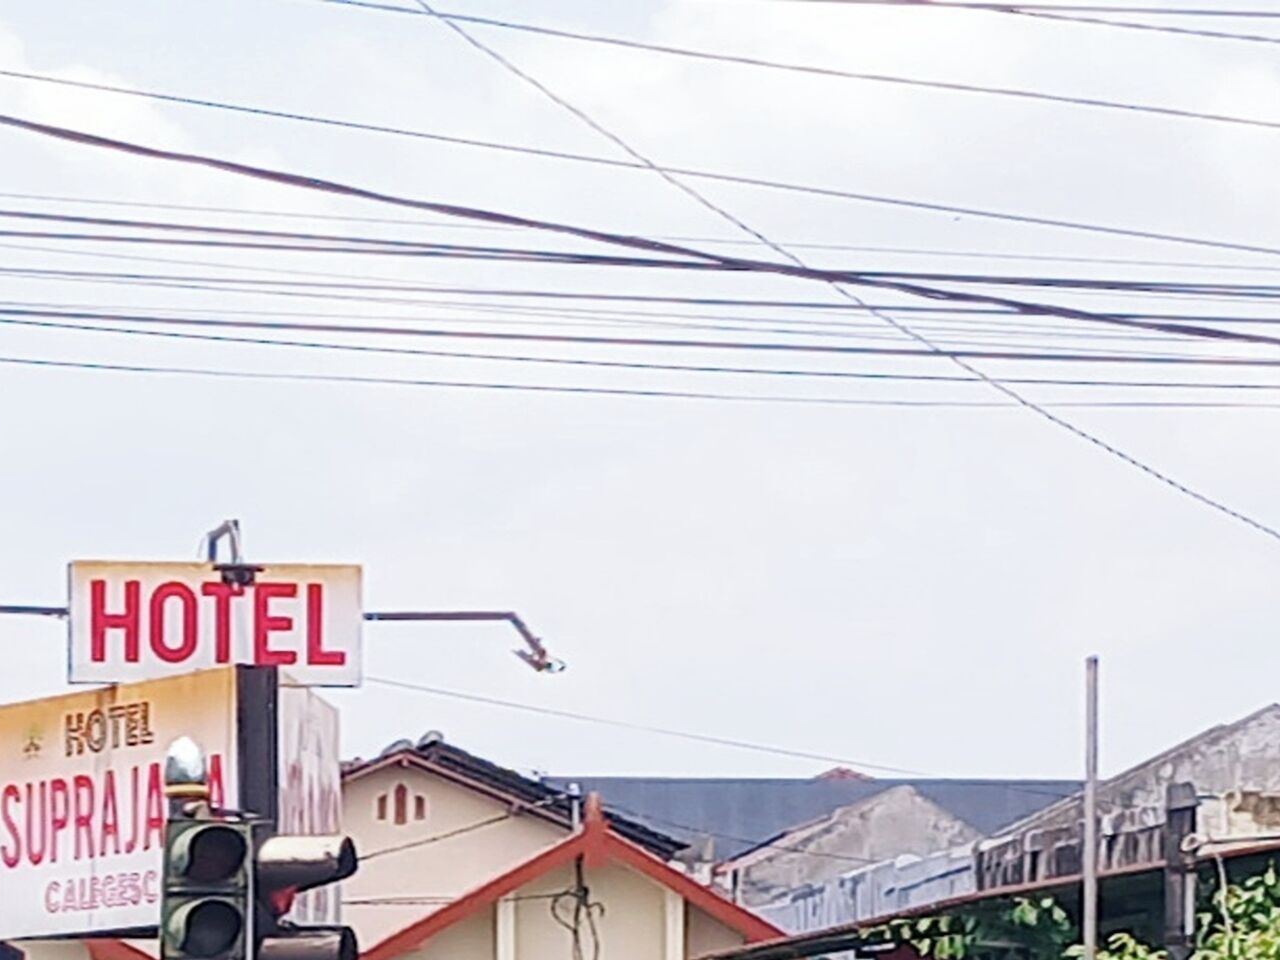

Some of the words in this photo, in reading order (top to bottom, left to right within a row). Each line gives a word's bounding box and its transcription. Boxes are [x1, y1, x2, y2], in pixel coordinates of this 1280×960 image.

[90, 579, 347, 667] HOTEL
[65, 701, 155, 758] HOTEL
[0, 753, 225, 869] SUPRAJAA
[44, 870, 160, 914] CALEGESC
